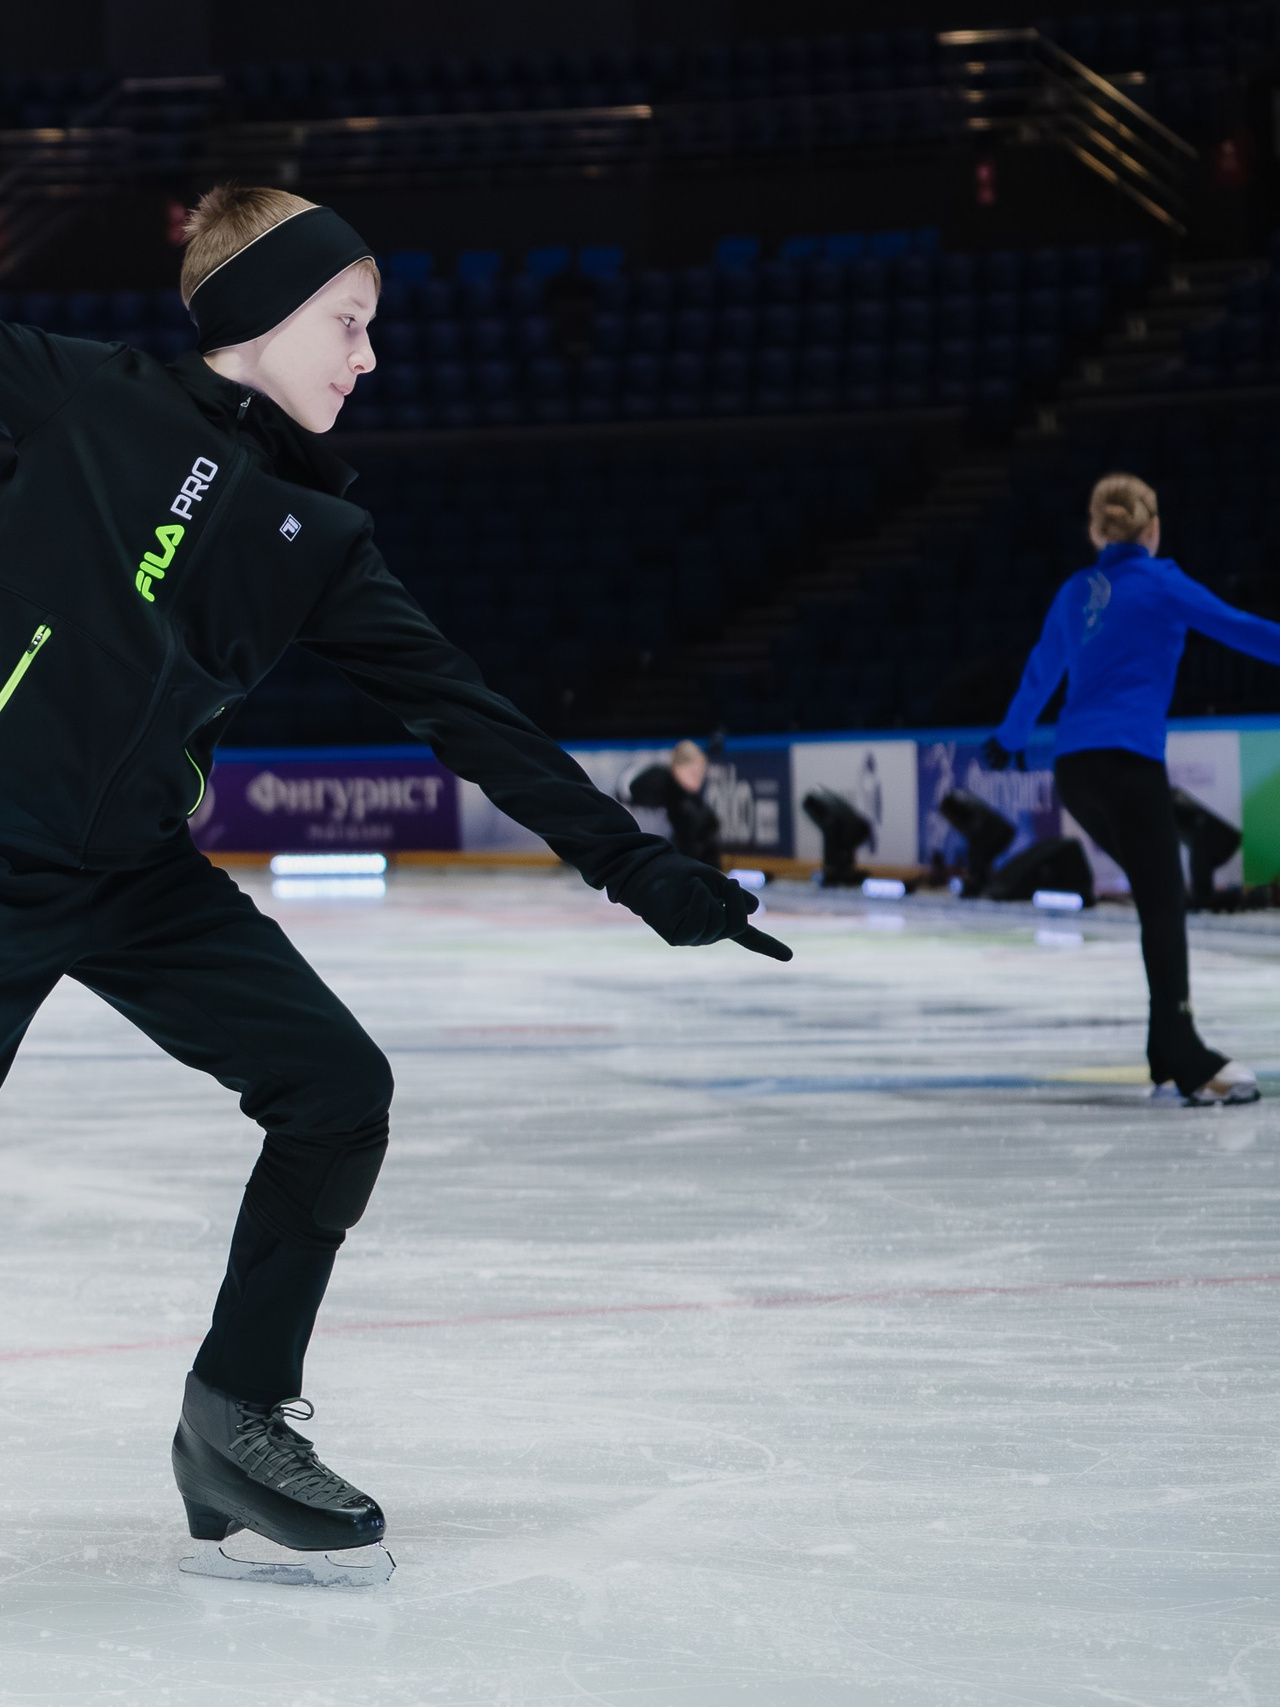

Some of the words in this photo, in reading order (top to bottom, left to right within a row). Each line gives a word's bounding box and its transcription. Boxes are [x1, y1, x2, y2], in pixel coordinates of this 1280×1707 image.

[135, 524, 185, 602] FILA
[170, 456, 219, 520] PRO
[248, 772, 443, 821] Фигурист
